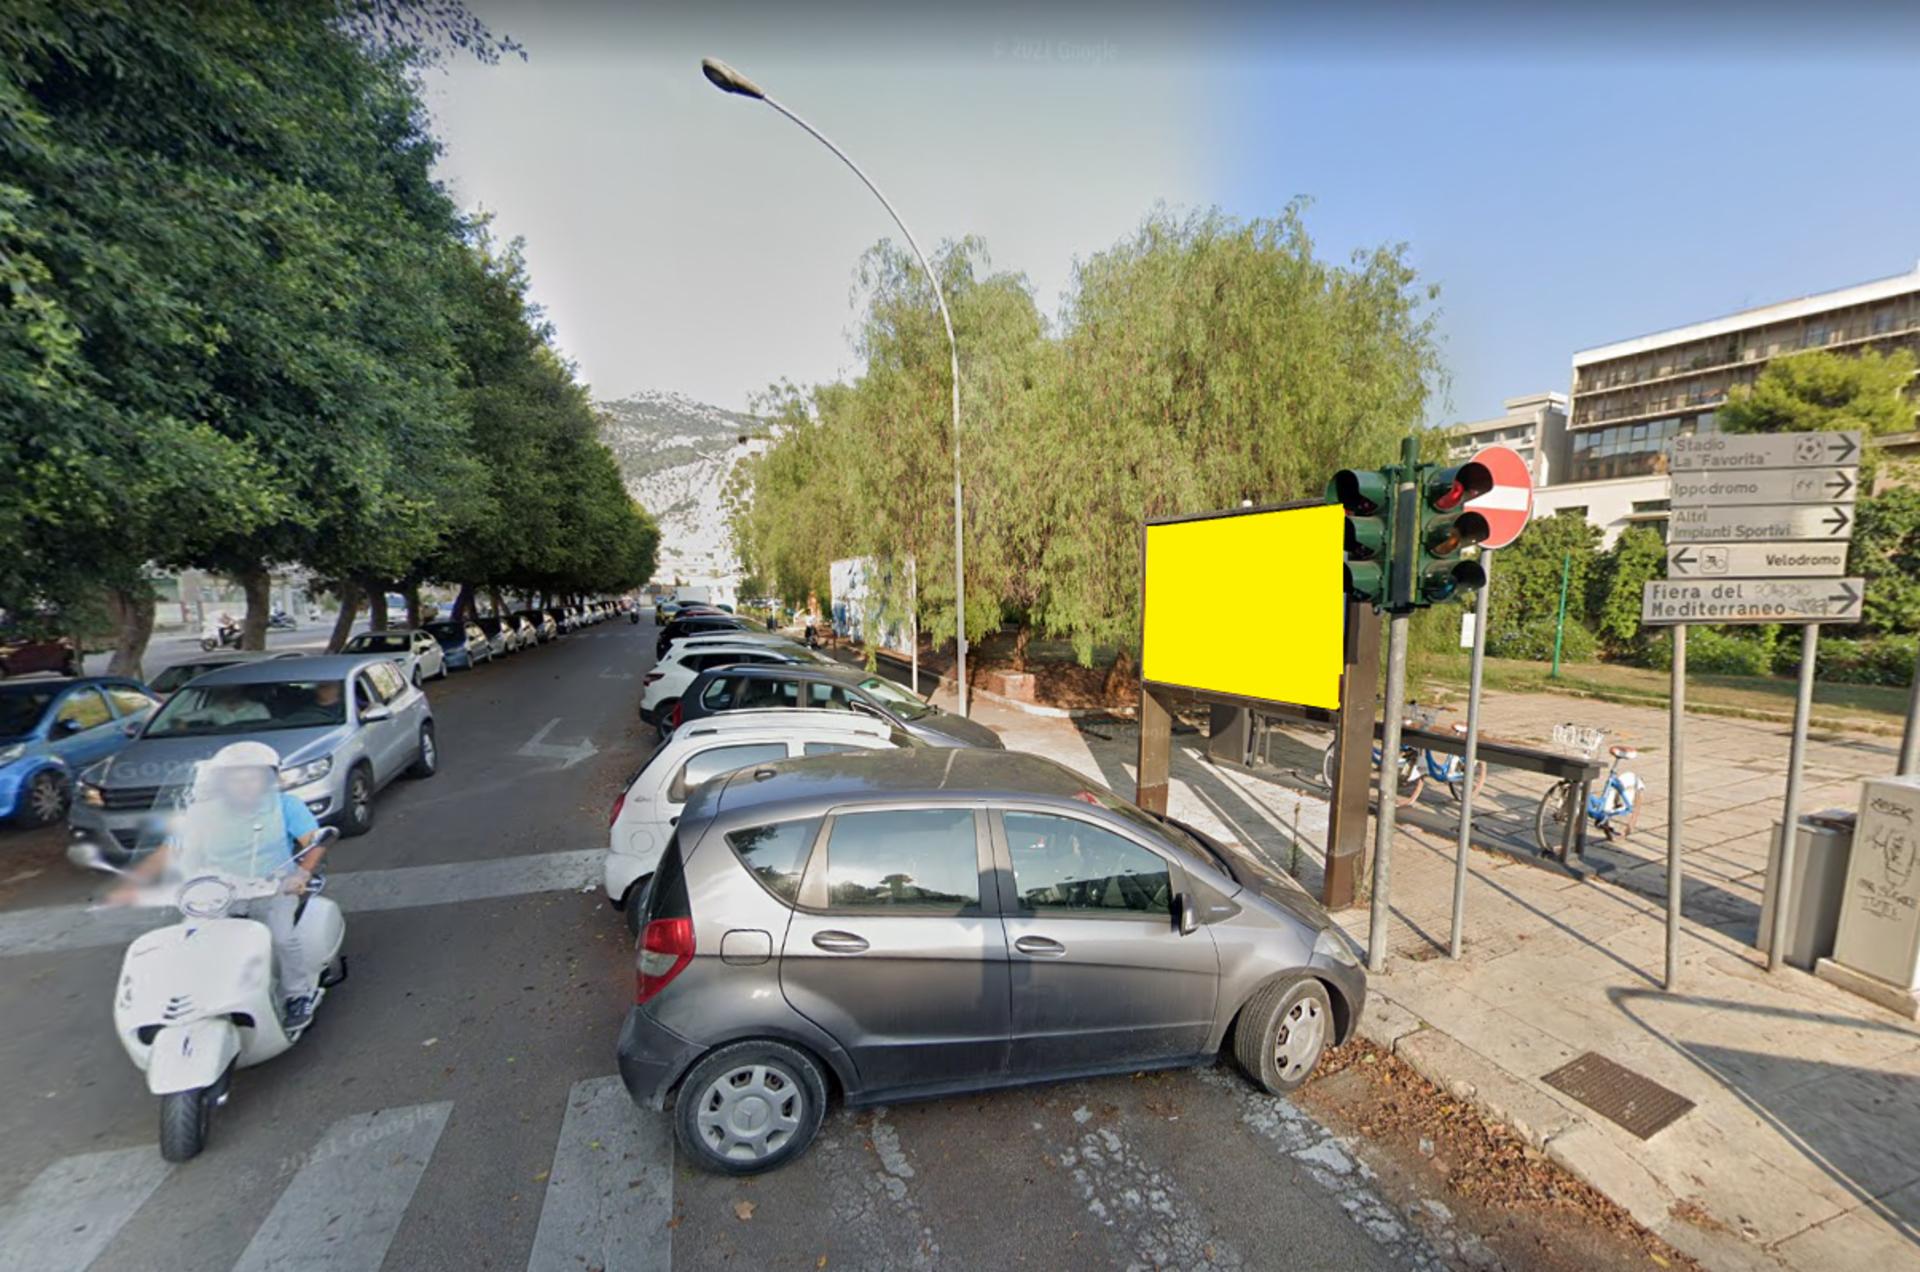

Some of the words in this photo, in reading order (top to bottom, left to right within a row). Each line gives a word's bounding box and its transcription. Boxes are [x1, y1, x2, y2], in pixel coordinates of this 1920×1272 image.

[1676, 438, 1726, 452] Stadio
[1674, 455, 1693, 468] La
[1675, 483, 1758, 498] Ippodromo
[1676, 510, 1708, 522] Altri
[1675, 526, 1731, 540] Impianti
[1735, 524, 1791, 540] Sportivi
[1765, 554, 1841, 567] Velodromo
[1652, 583, 1702, 600] Fiera
[1711, 583, 1743, 599] del
[1651, 601, 1786, 617] Mediterraneo
